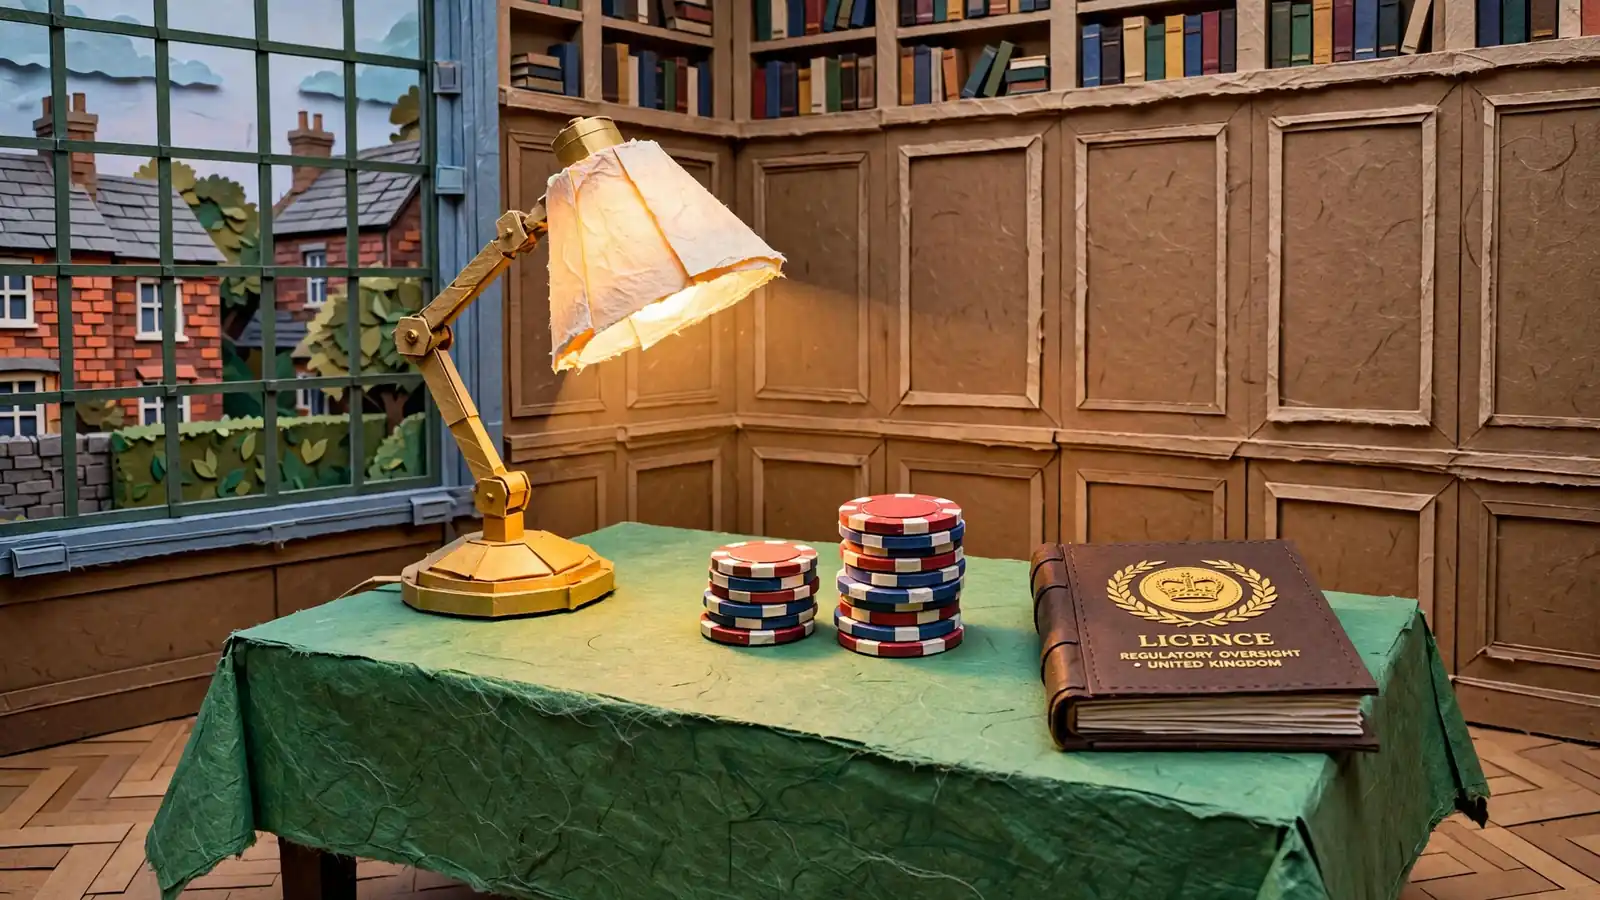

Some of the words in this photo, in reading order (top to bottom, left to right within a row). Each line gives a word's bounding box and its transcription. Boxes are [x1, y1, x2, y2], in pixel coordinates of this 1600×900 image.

[1138, 633, 1275, 648] LICENCE
[1120, 651, 1213, 660] REGULATORY
[1219, 649, 1301, 659] OVERSIGHT
[1147, 659, 1204, 669] UNITED
[1209, 659, 1282, 668] KINGDOM
